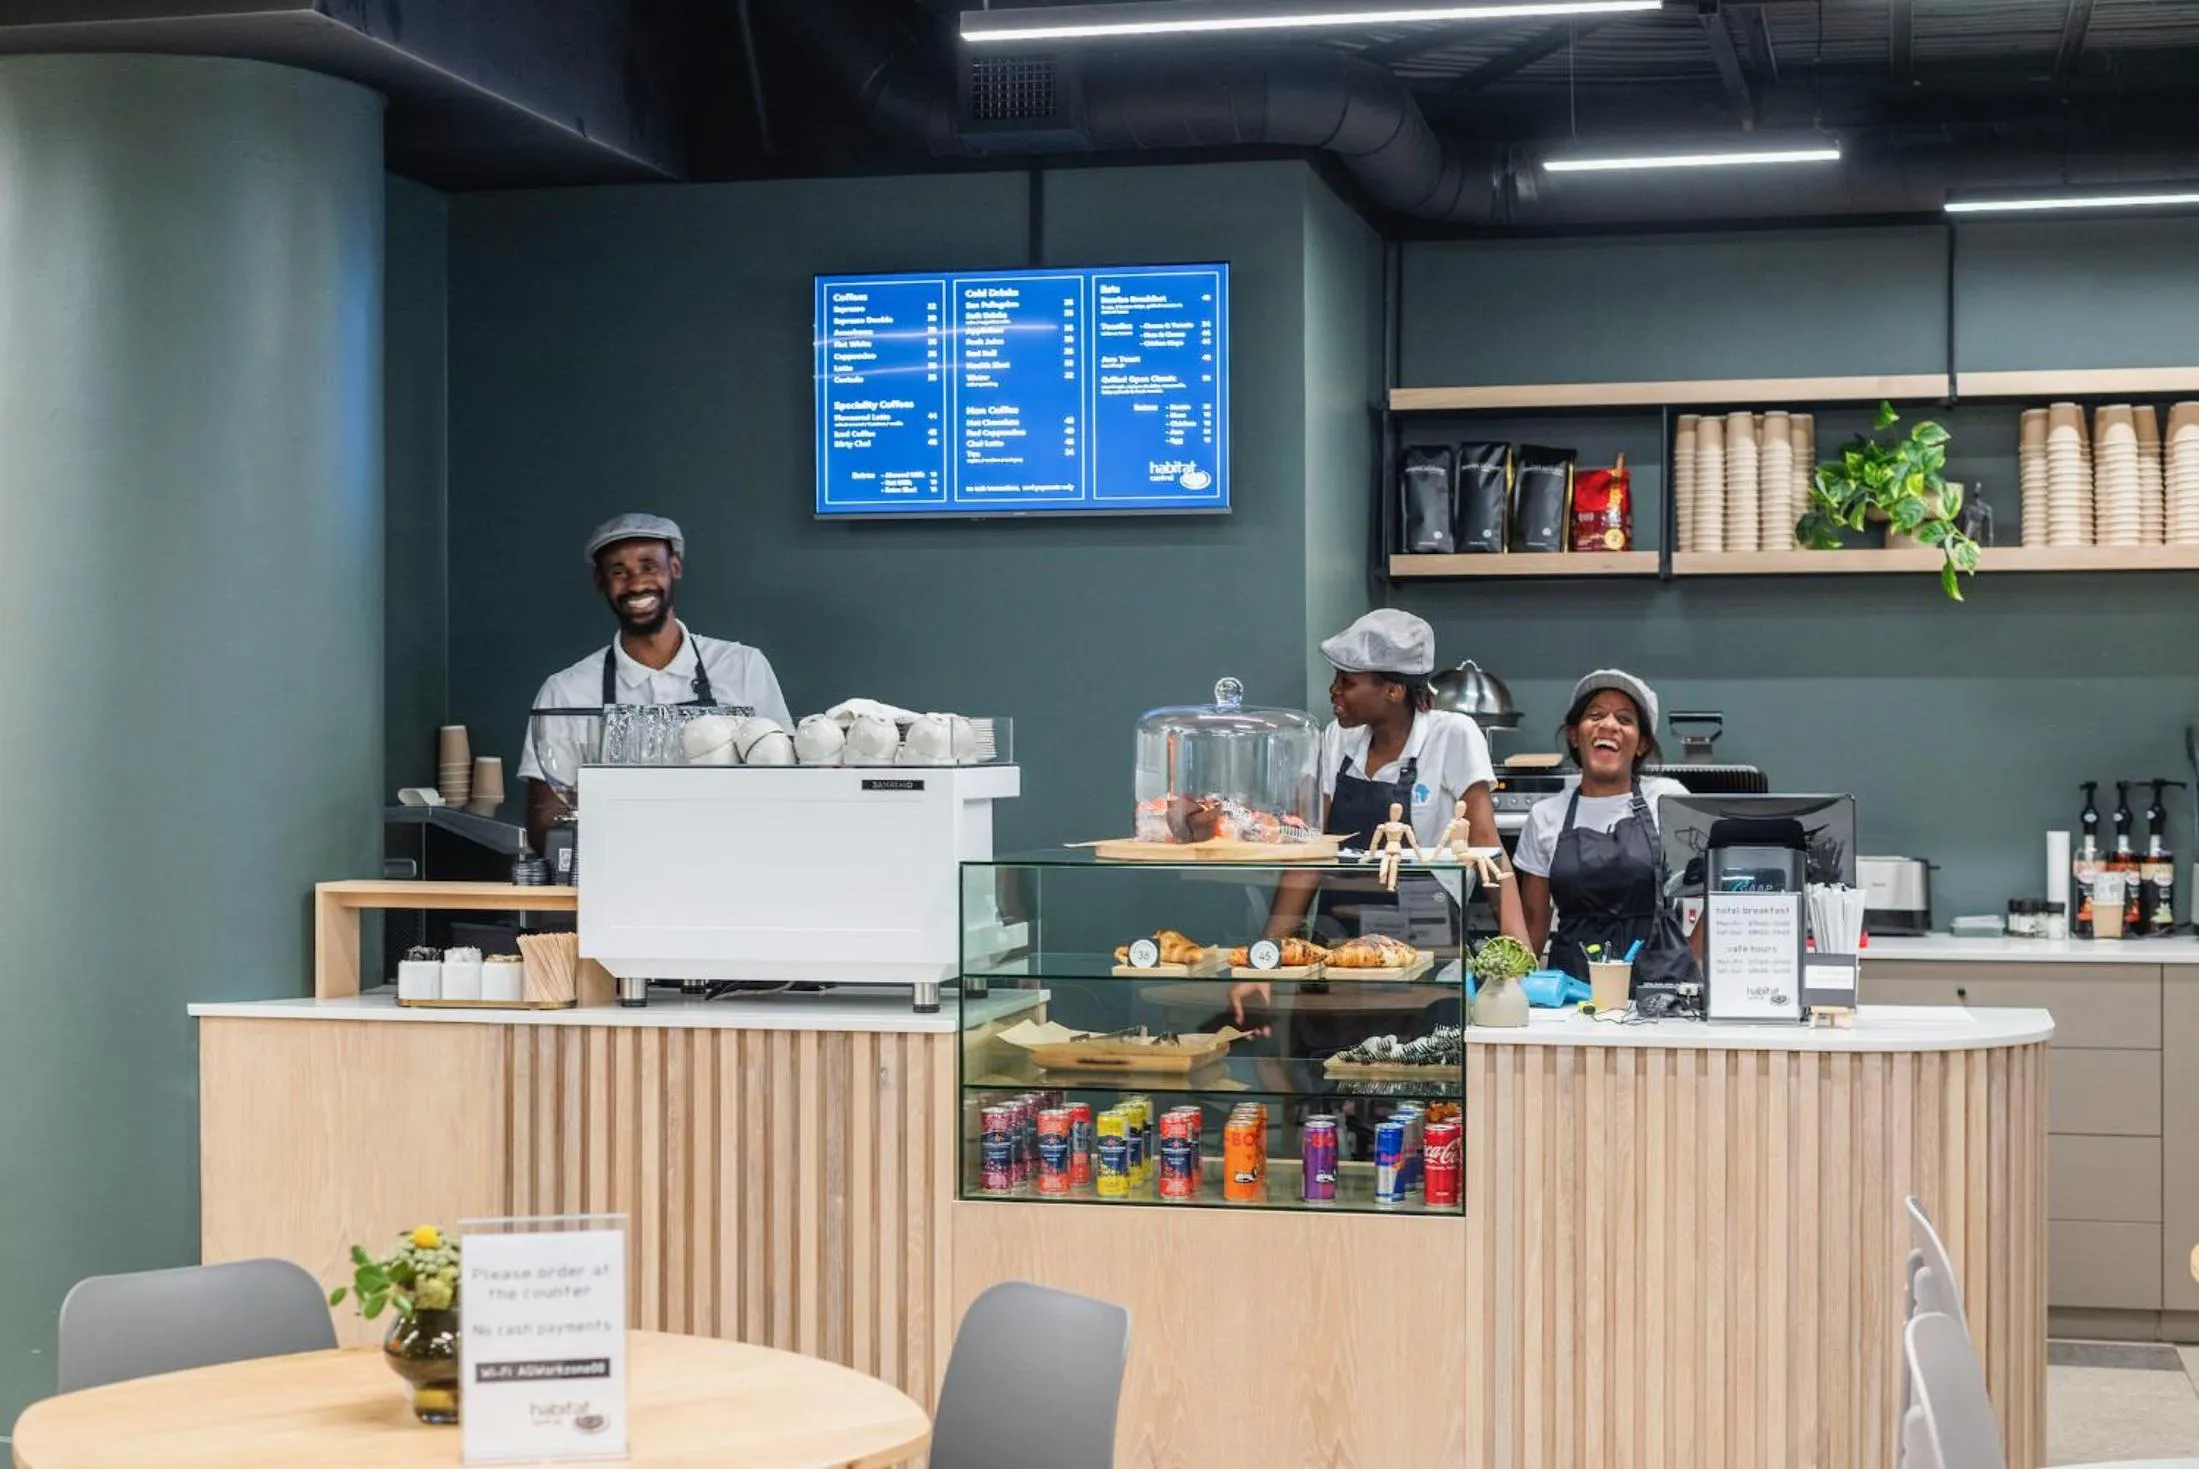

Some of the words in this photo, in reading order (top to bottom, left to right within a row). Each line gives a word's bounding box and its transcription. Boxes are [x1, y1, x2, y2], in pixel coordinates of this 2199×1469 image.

[1149, 460, 1196, 474] habitat
[472, 1267, 531, 1282] Please
[537, 1264, 585, 1280] order
[592, 1263, 610, 1277] at
[488, 1288, 517, 1301] the
[522, 1285, 592, 1300] counter
[473, 1324, 492, 1337] No
[498, 1322, 532, 1336] cash
[536, 1319, 612, 1336] payments
